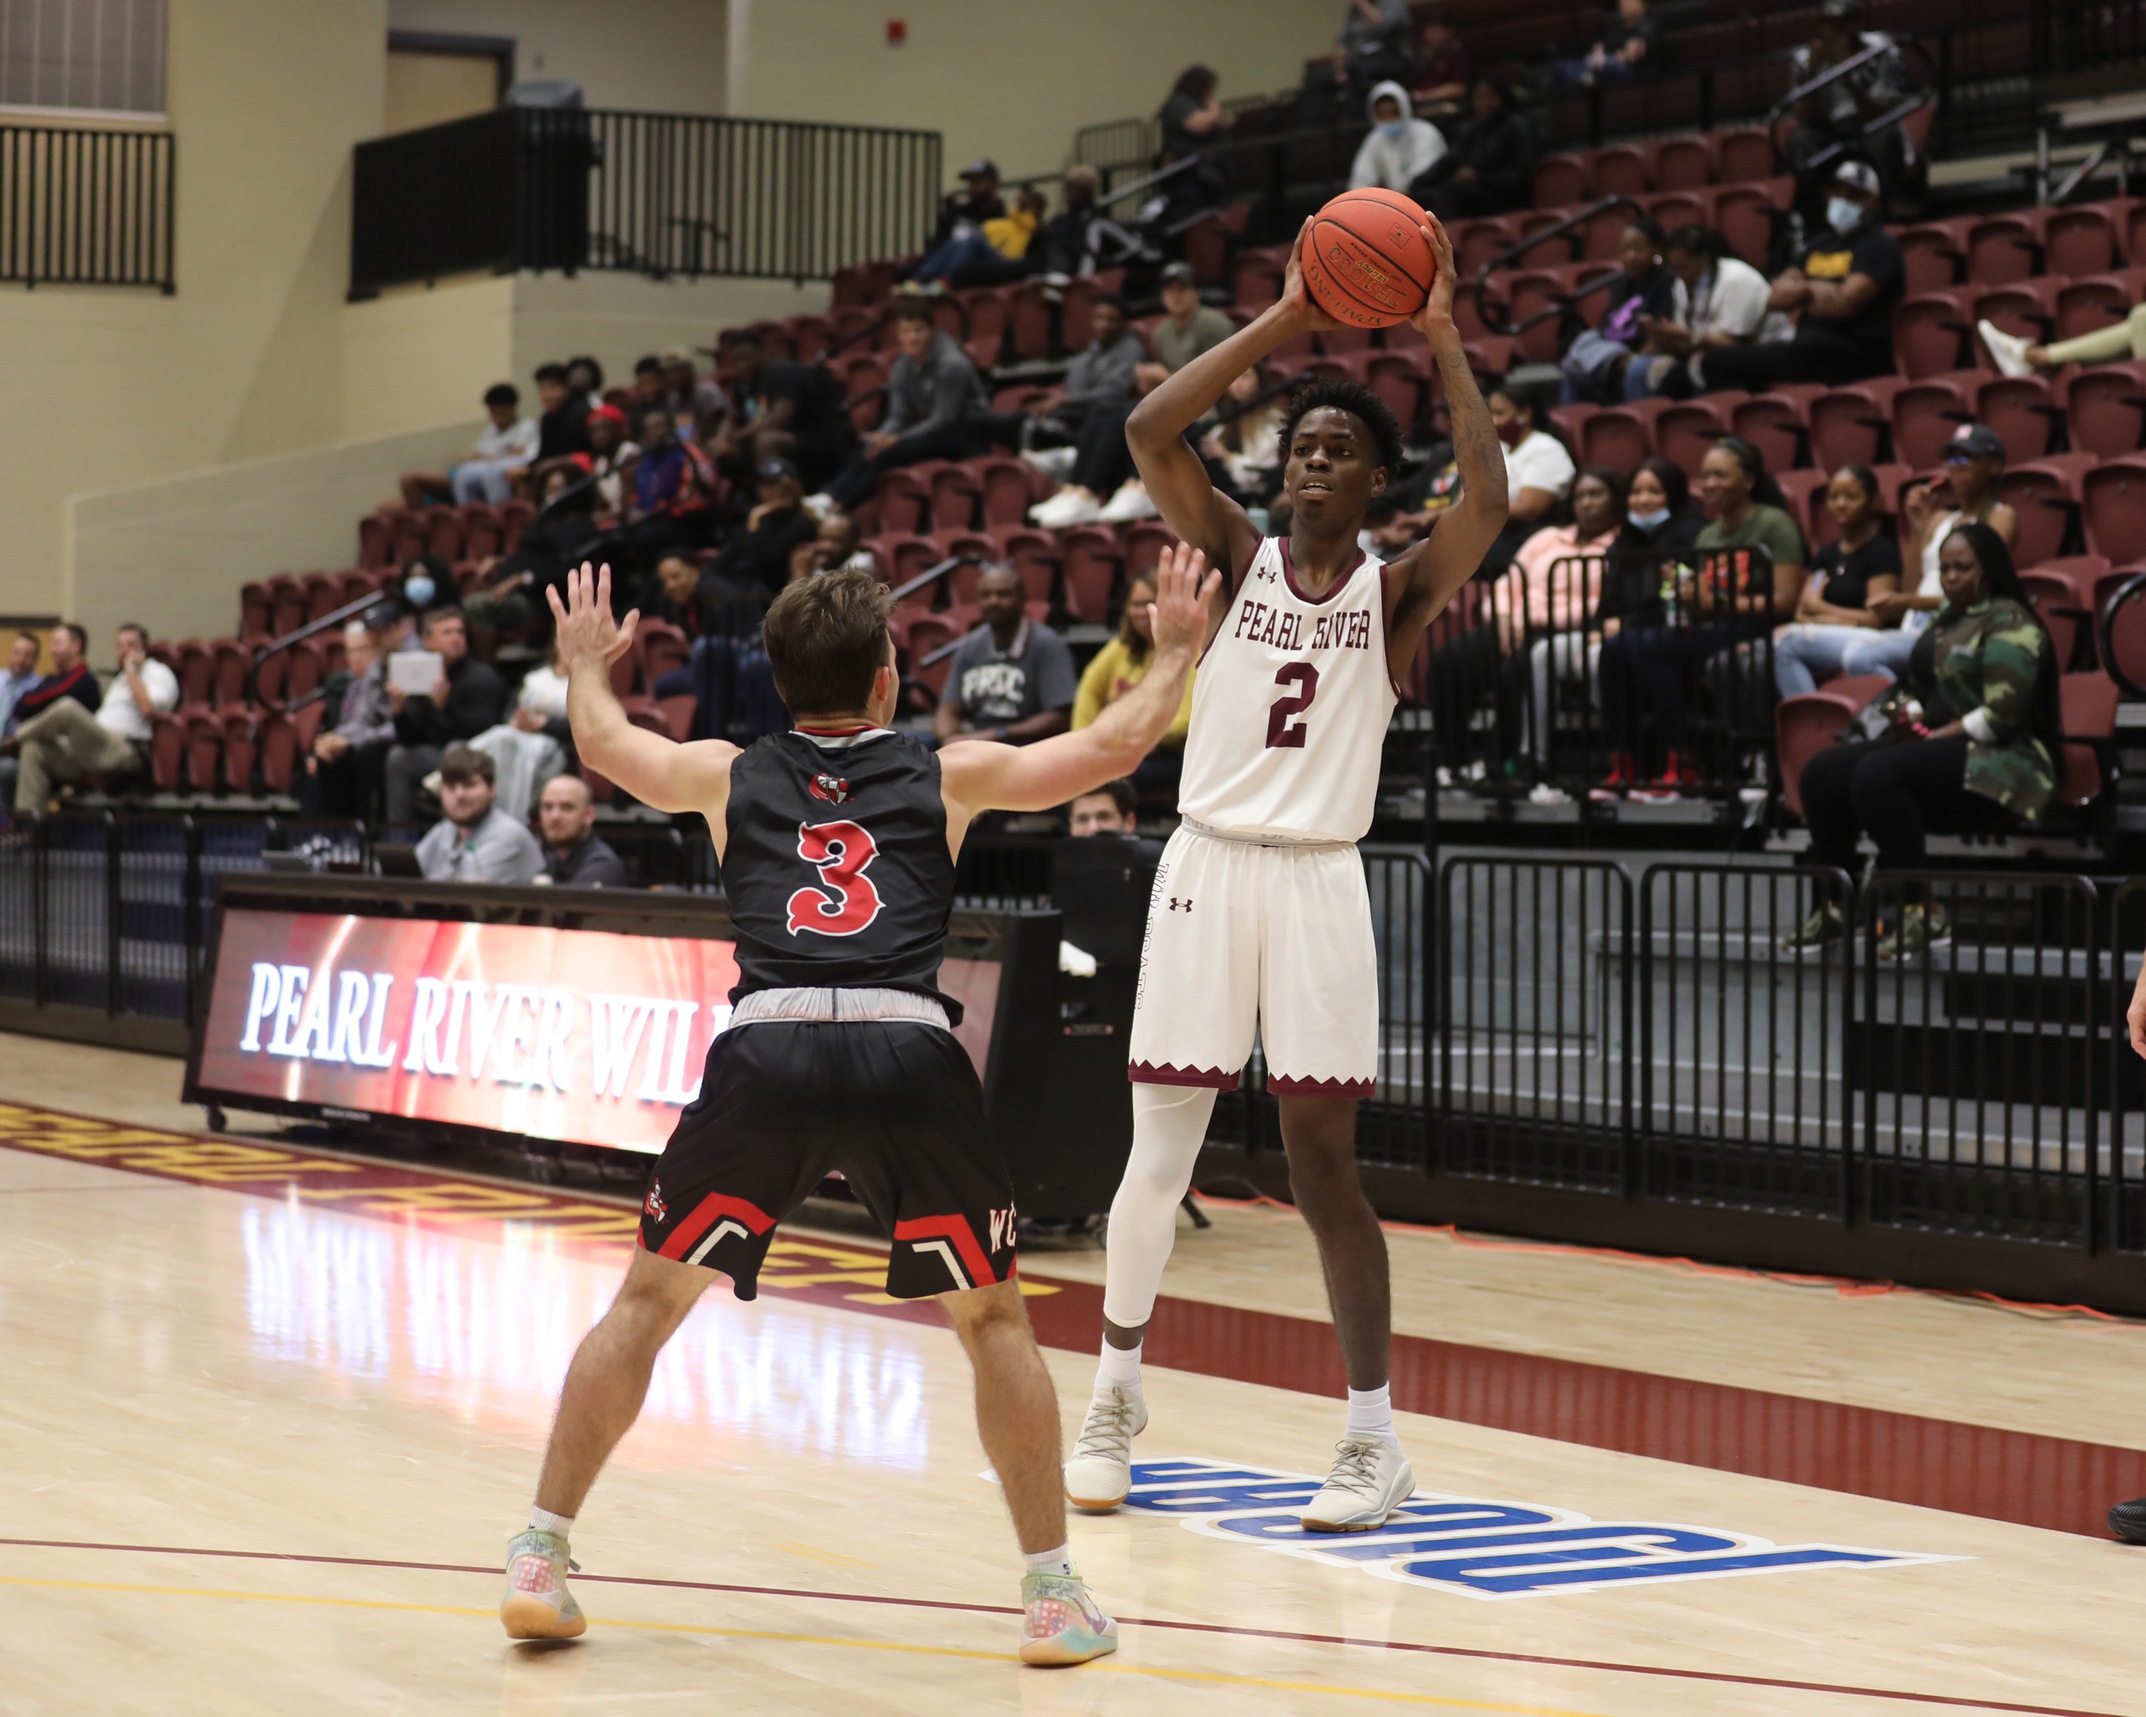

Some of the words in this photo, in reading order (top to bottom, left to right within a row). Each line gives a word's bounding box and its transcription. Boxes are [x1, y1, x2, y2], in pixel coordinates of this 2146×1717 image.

[1307, 264, 1384, 326] SPALDING
[1356, 259, 1389, 284] LEGACY
[1234, 599, 1303, 650] PEARL
[1311, 609, 1371, 650] RIVER
[1265, 661, 1320, 749] 2
[786, 819, 887, 937] 3
[239, 961, 399, 1069] PEARL
[401, 975, 579, 1093] RIVER
[589, 990, 735, 1107] WIL
